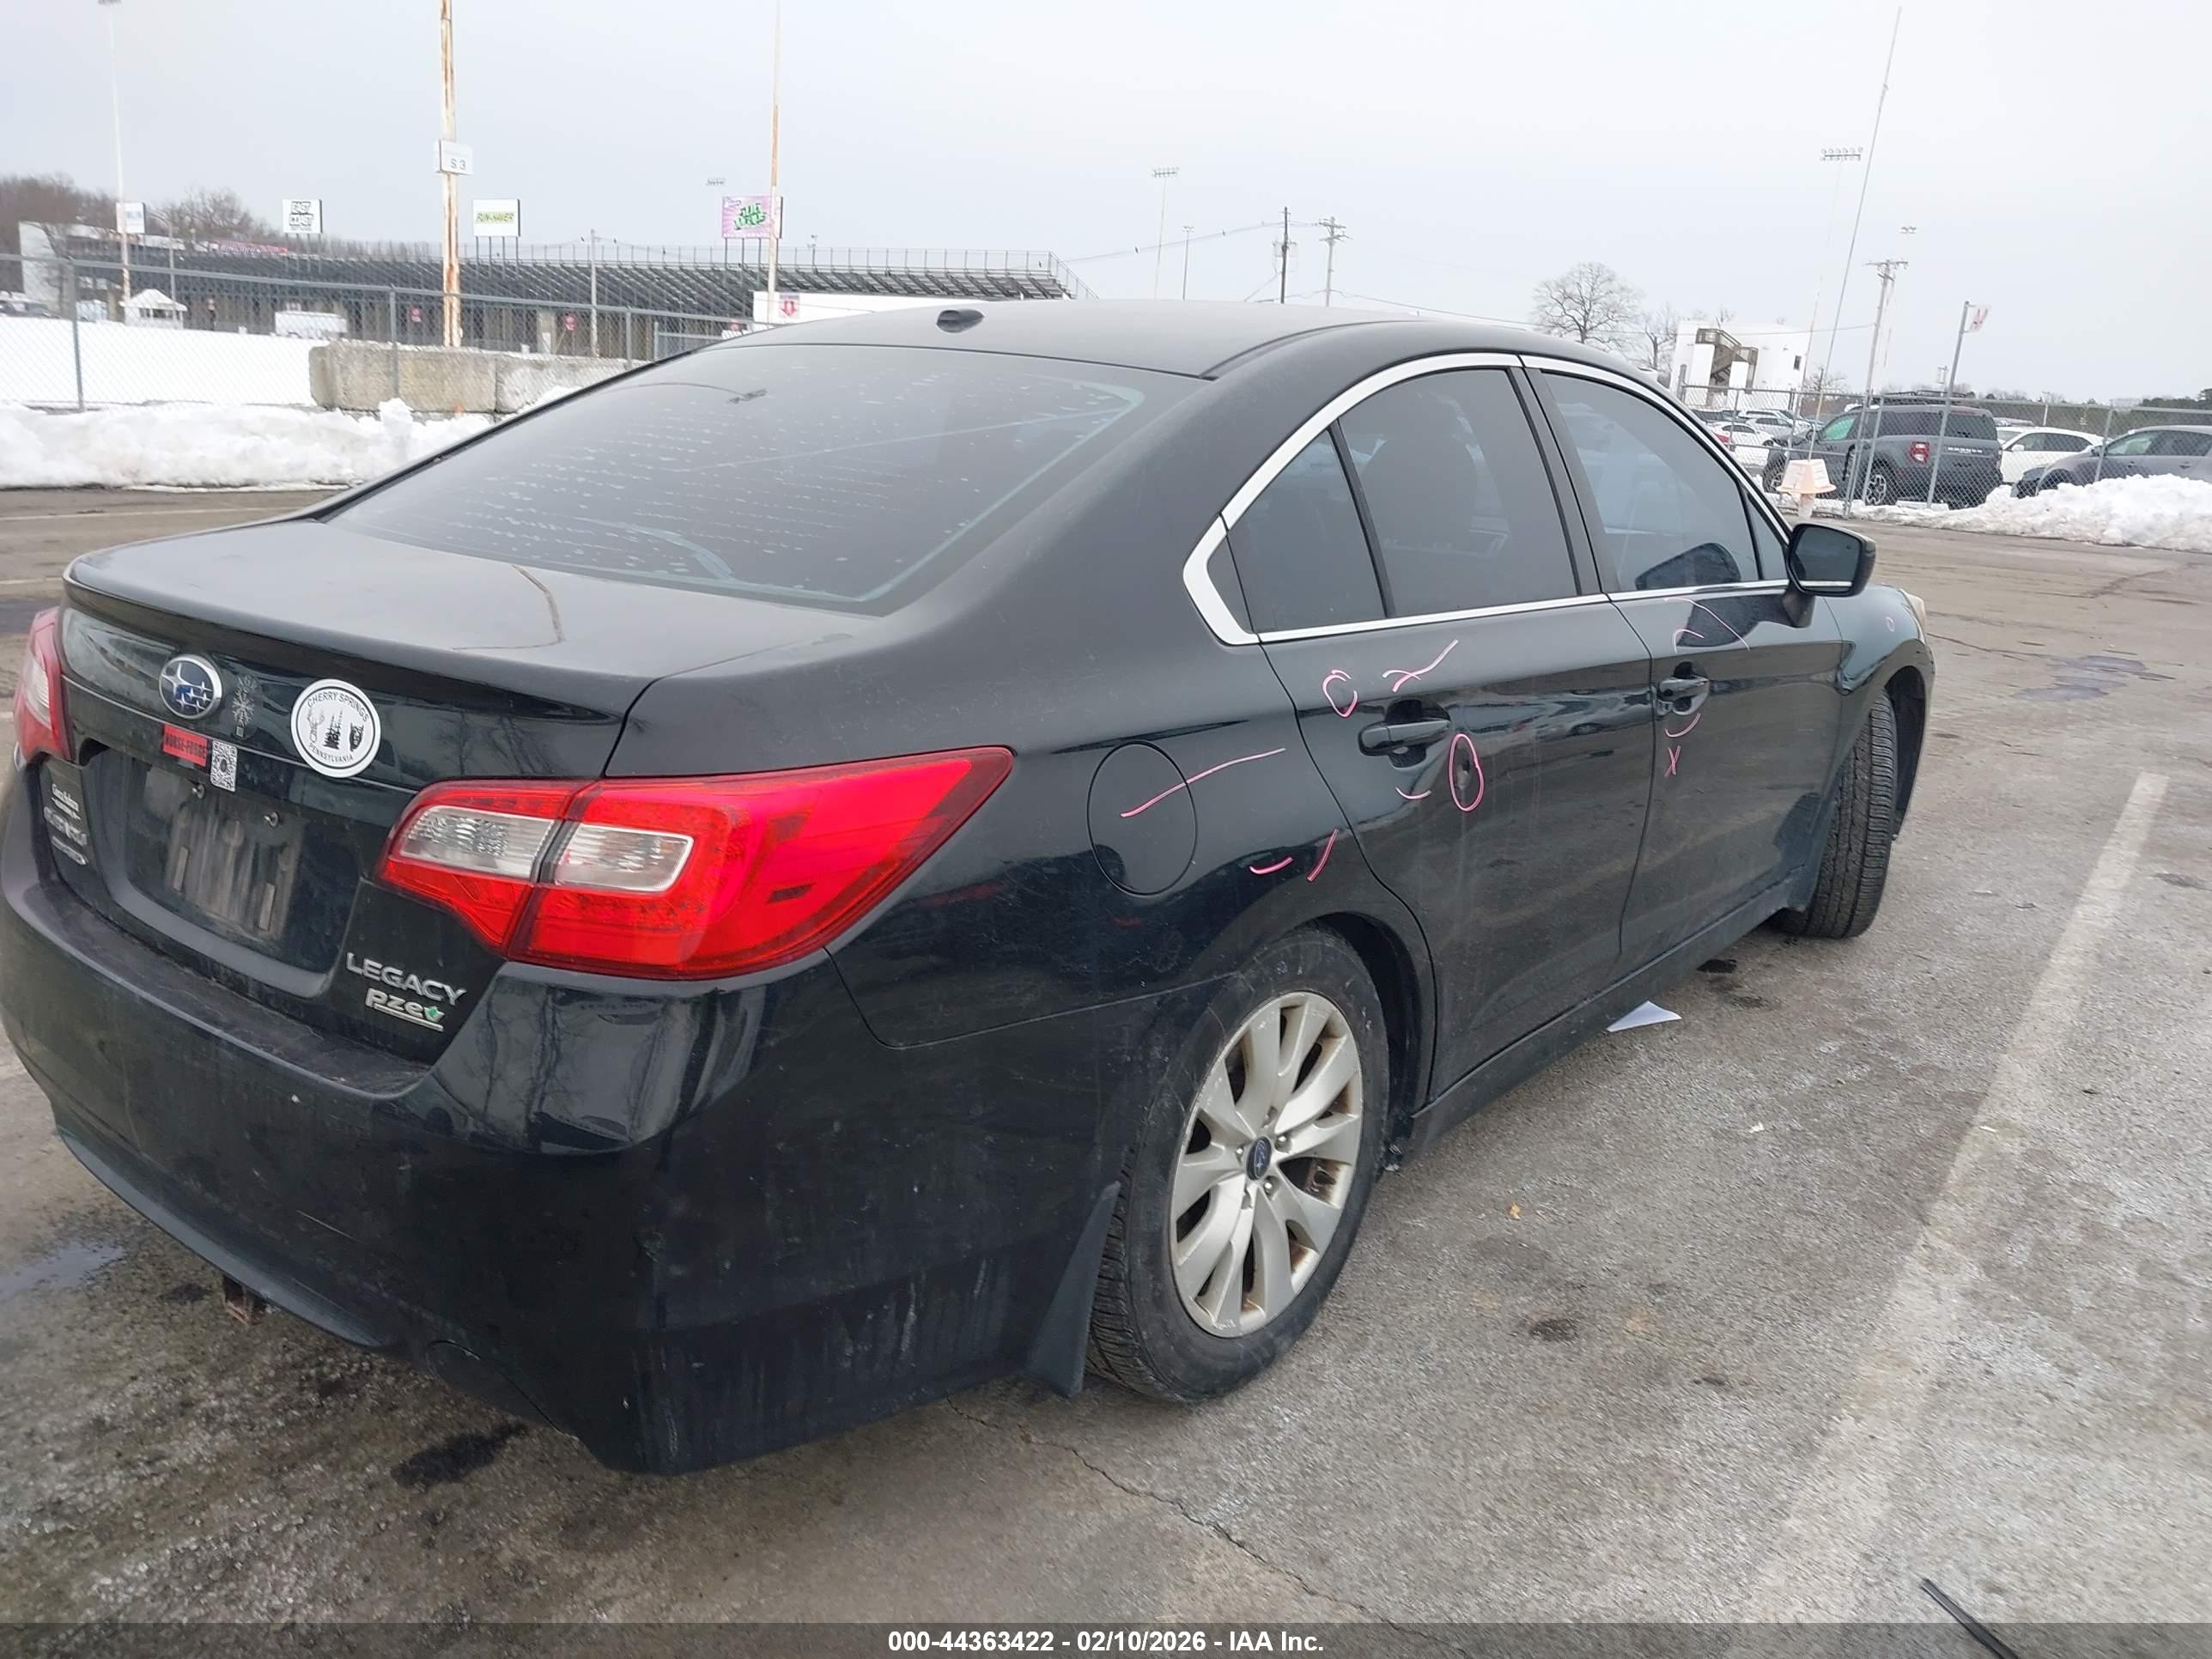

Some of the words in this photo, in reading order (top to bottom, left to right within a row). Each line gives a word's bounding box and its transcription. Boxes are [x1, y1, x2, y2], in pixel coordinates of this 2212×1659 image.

[307, 690, 338, 708] CHERRY
[338, 693, 369, 723] SPRINGS
[309, 742, 354, 763] PENNSYLVANIA
[346, 951, 467, 1006] LEGACY
